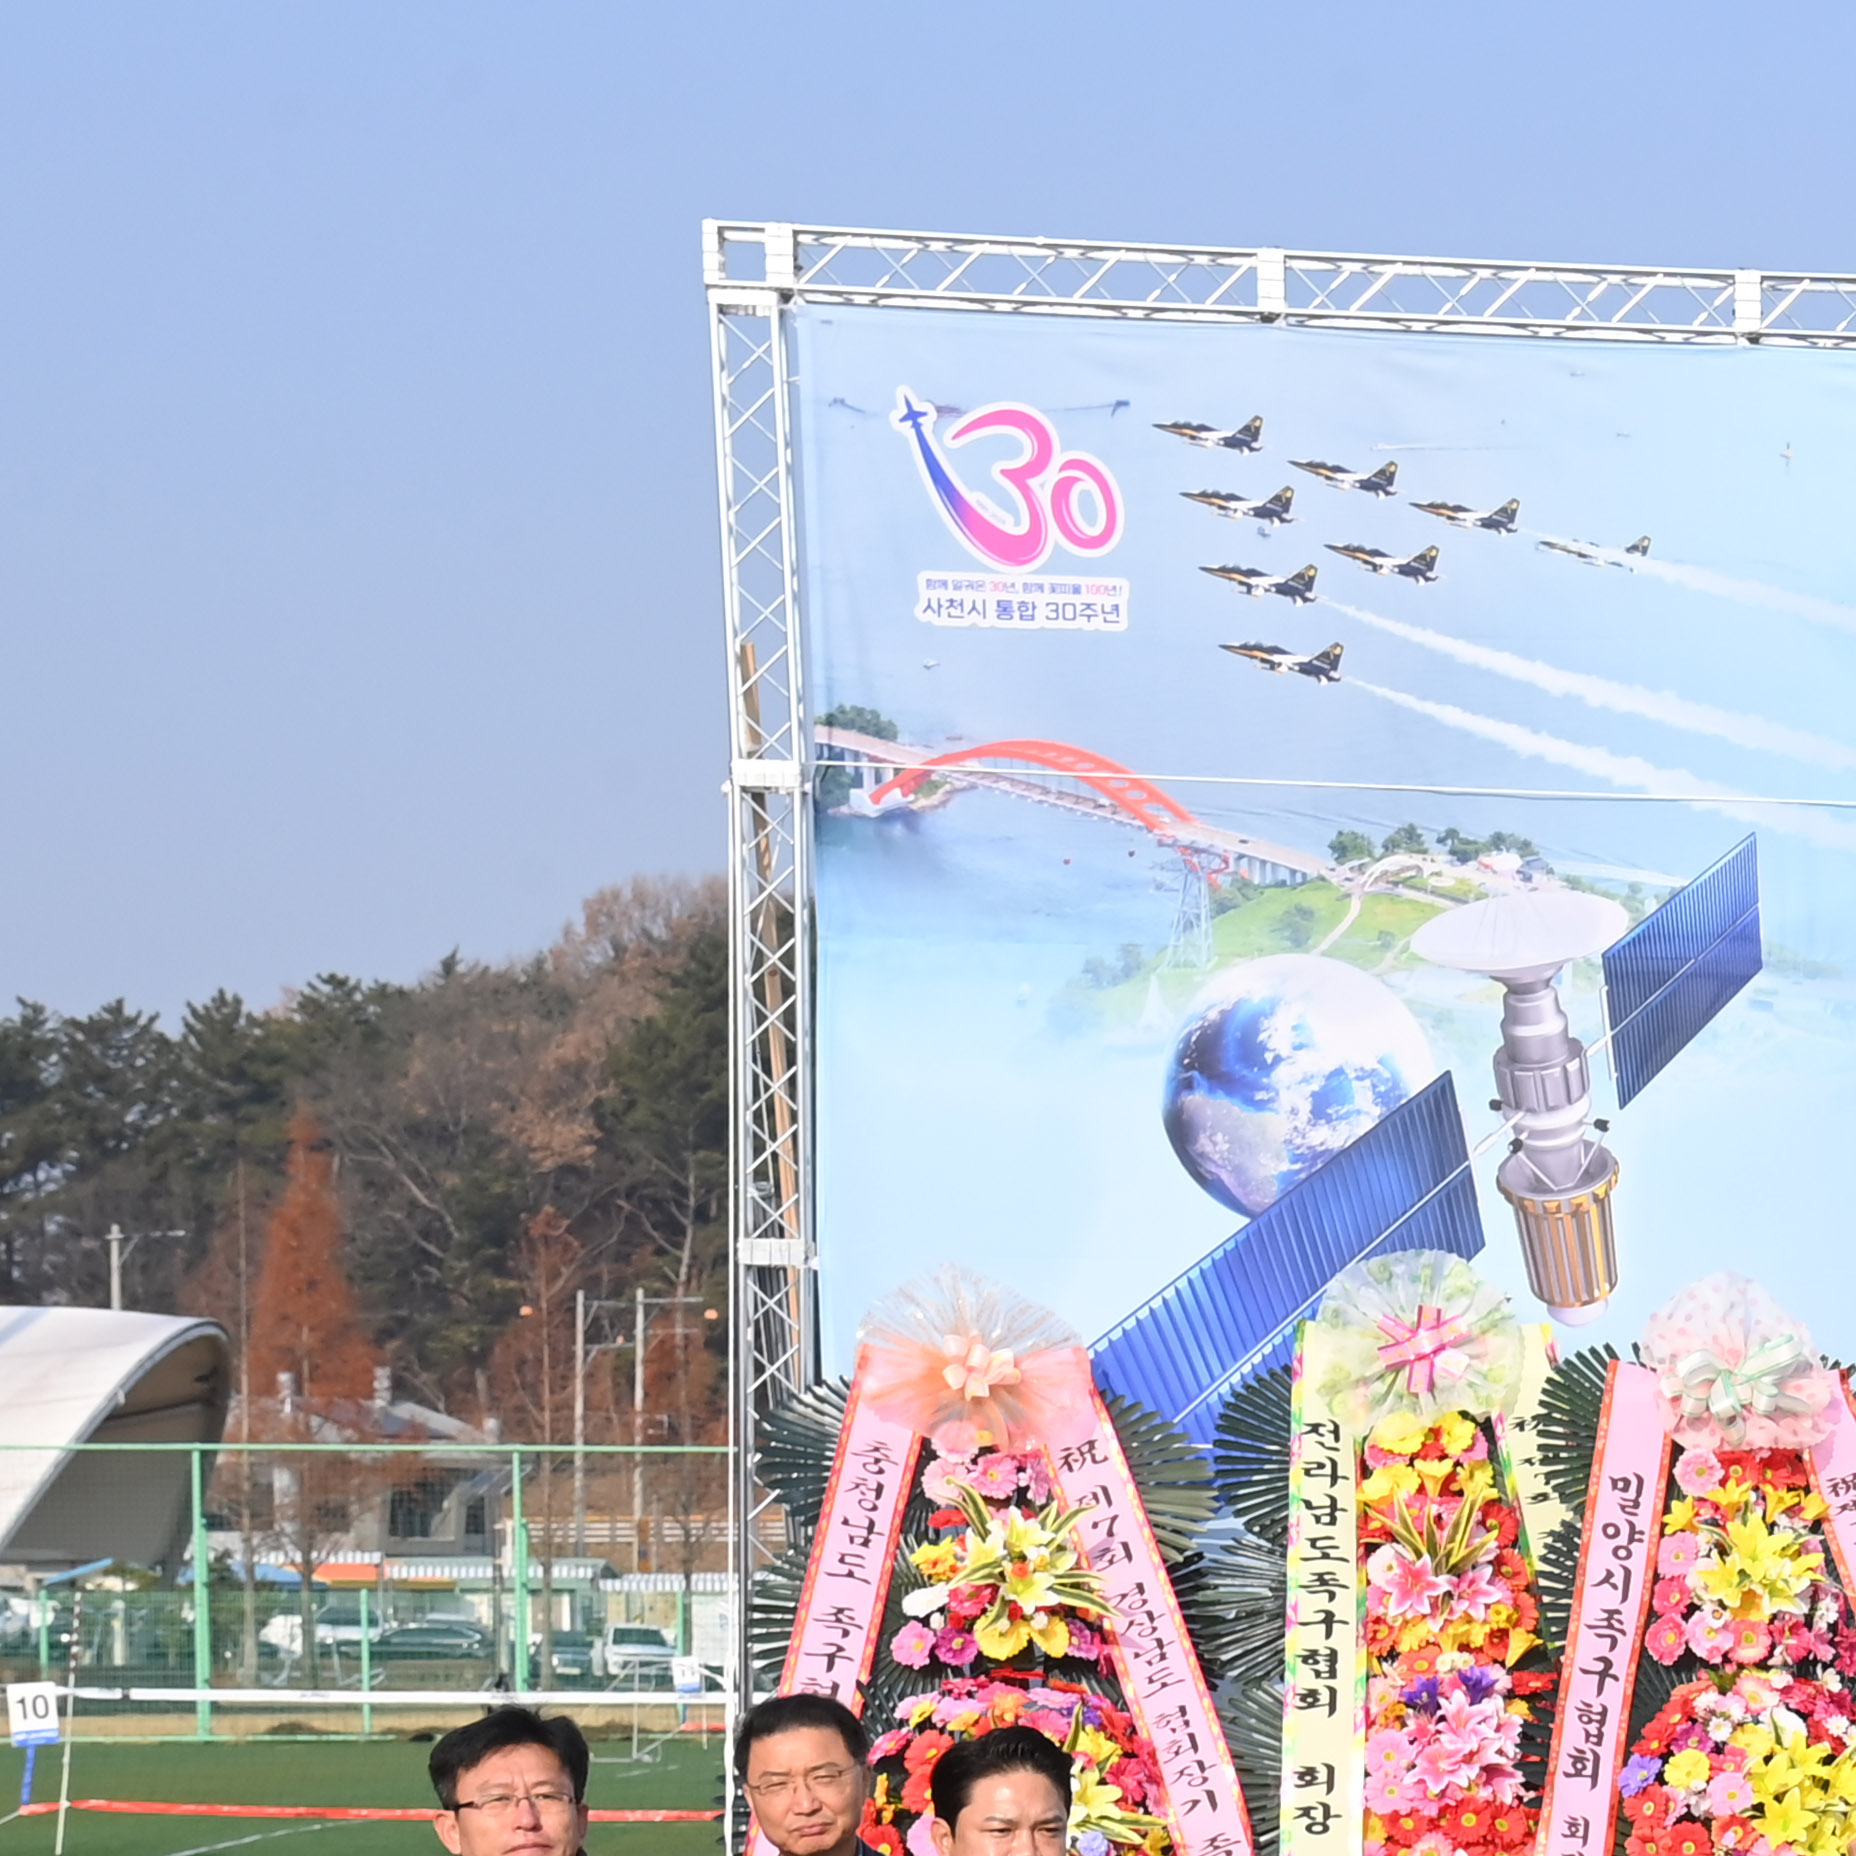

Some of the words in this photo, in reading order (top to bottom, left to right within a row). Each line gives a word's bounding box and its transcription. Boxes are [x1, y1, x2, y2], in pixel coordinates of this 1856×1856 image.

[930, 408, 1118, 567] 30
[922, 597, 987, 620] 사천시
[995, 599, 1037, 621] 통합
[1045, 602, 1121, 624] 30주년
[925, 578, 949, 591] 함께
[1022, 582, 1045, 594] 함께
[1085, 583, 1122, 597] 100년!
[1058, 1438, 1109, 1474] 祝
[824, 1440, 900, 1585] 충청남도
[1075, 1484, 1134, 1570] 제7회
[1295, 1419, 1350, 1719] 전라남도족구협회
[1111, 1579, 1186, 1700] 경상남도
[1561, 1470, 1646, 1793] 밀양시족구협회
[16, 1694, 49, 1720] 10
[1152, 1703, 1221, 1819] 협회장기
[1292, 1761, 1343, 1835] 회장
